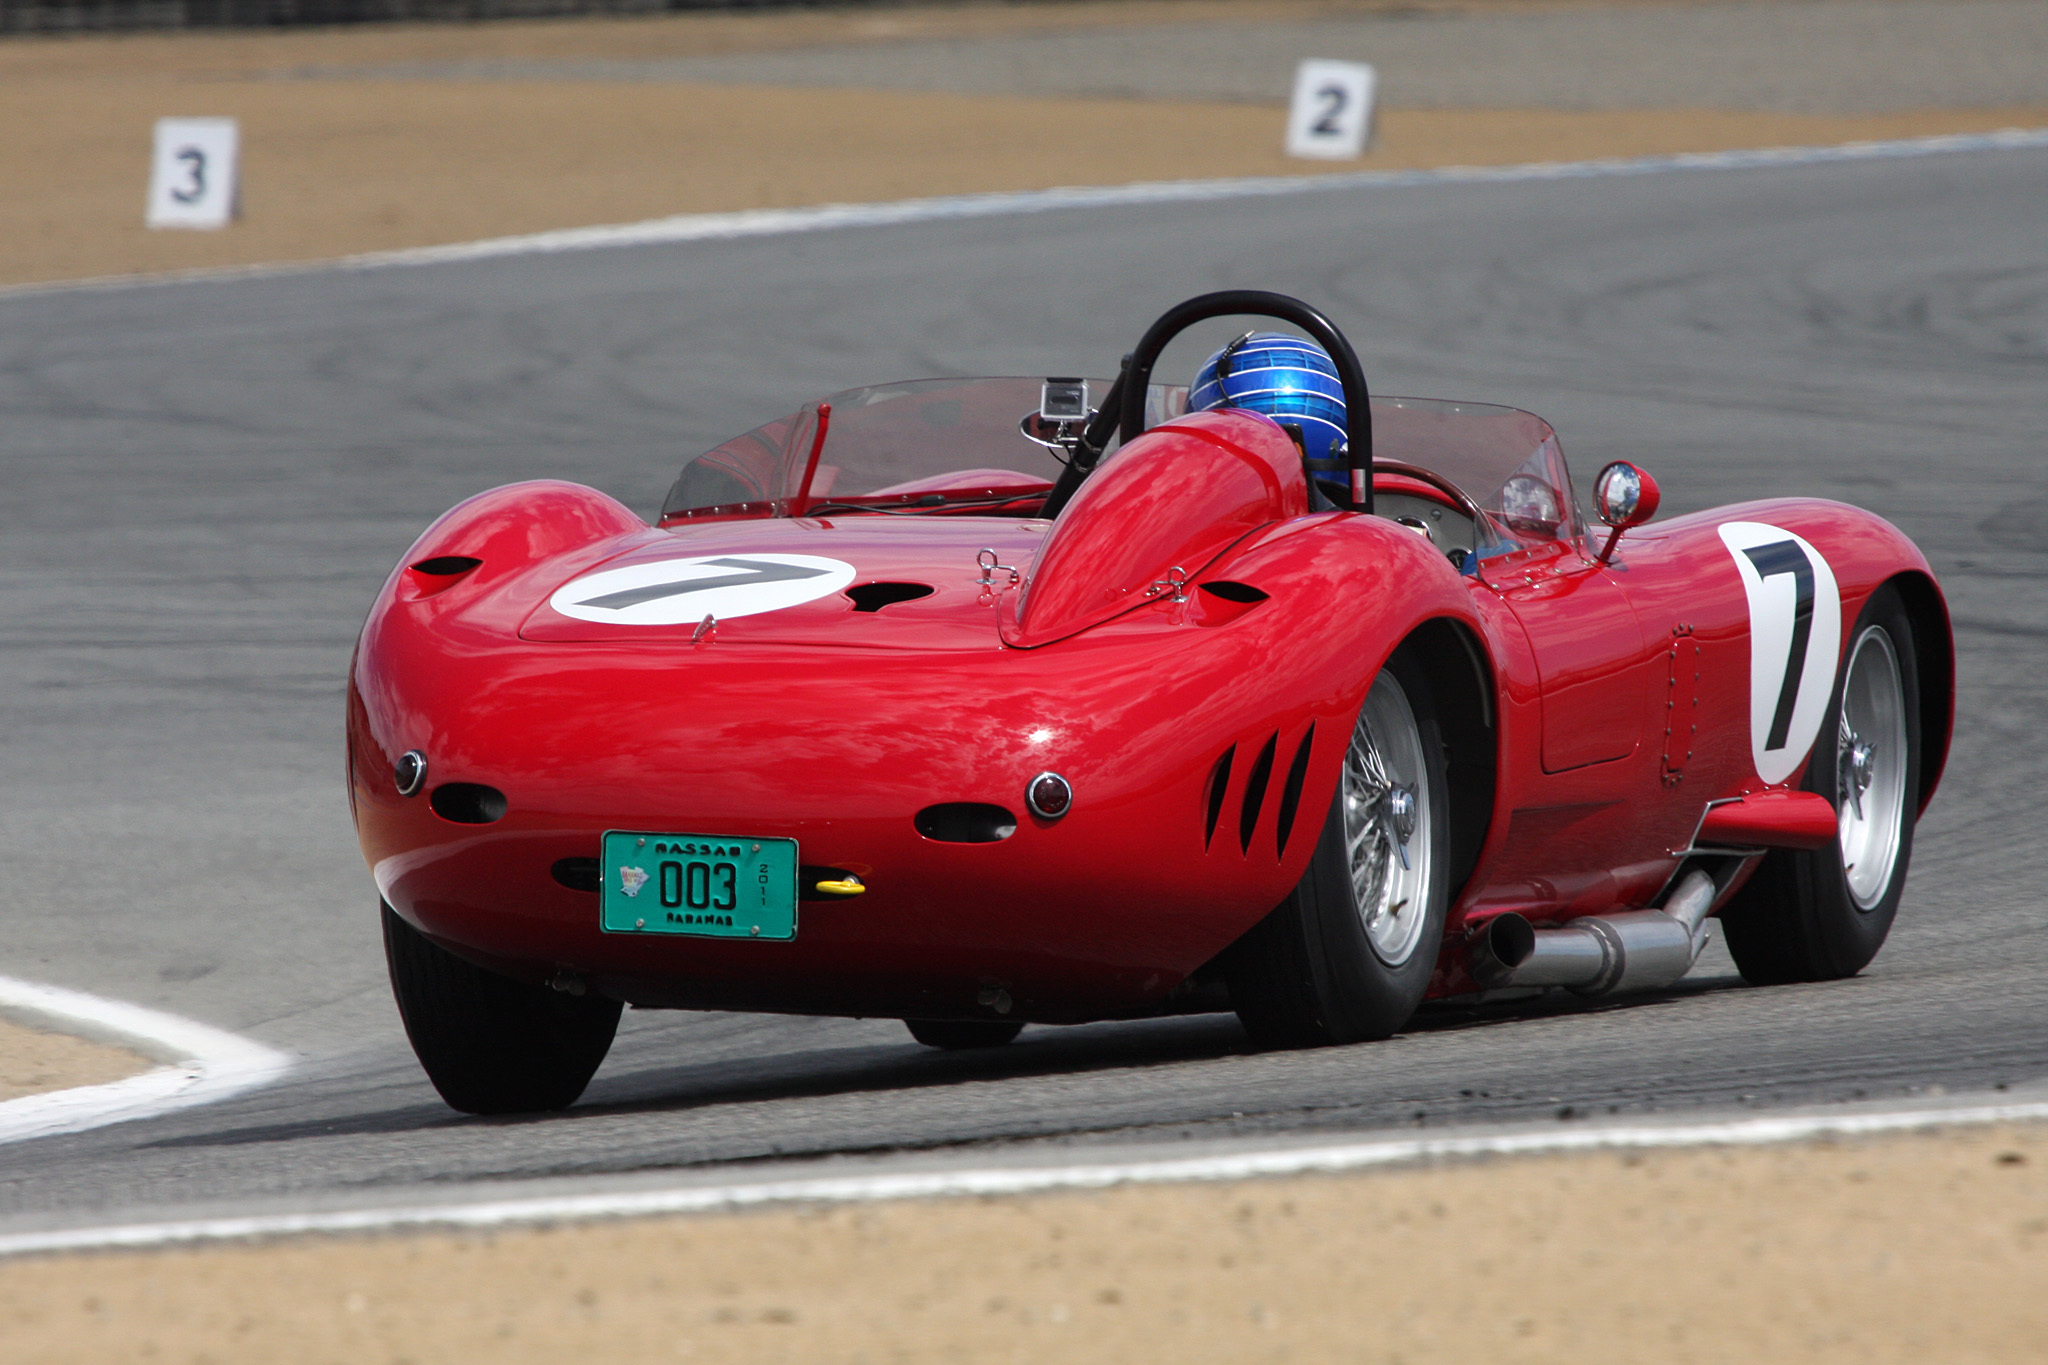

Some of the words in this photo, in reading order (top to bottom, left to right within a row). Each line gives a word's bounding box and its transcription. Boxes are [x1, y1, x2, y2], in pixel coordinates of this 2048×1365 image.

[1308, 84, 1350, 138] 2
[170, 147, 207, 204] 3
[571, 558, 834, 610] 7
[1741, 539, 1816, 751] 7
[655, 843, 741, 857] NASSAU
[660, 860, 737, 910] 003
[758, 864, 769, 906] 2011
[666, 912, 733, 926] BAHAMAS
